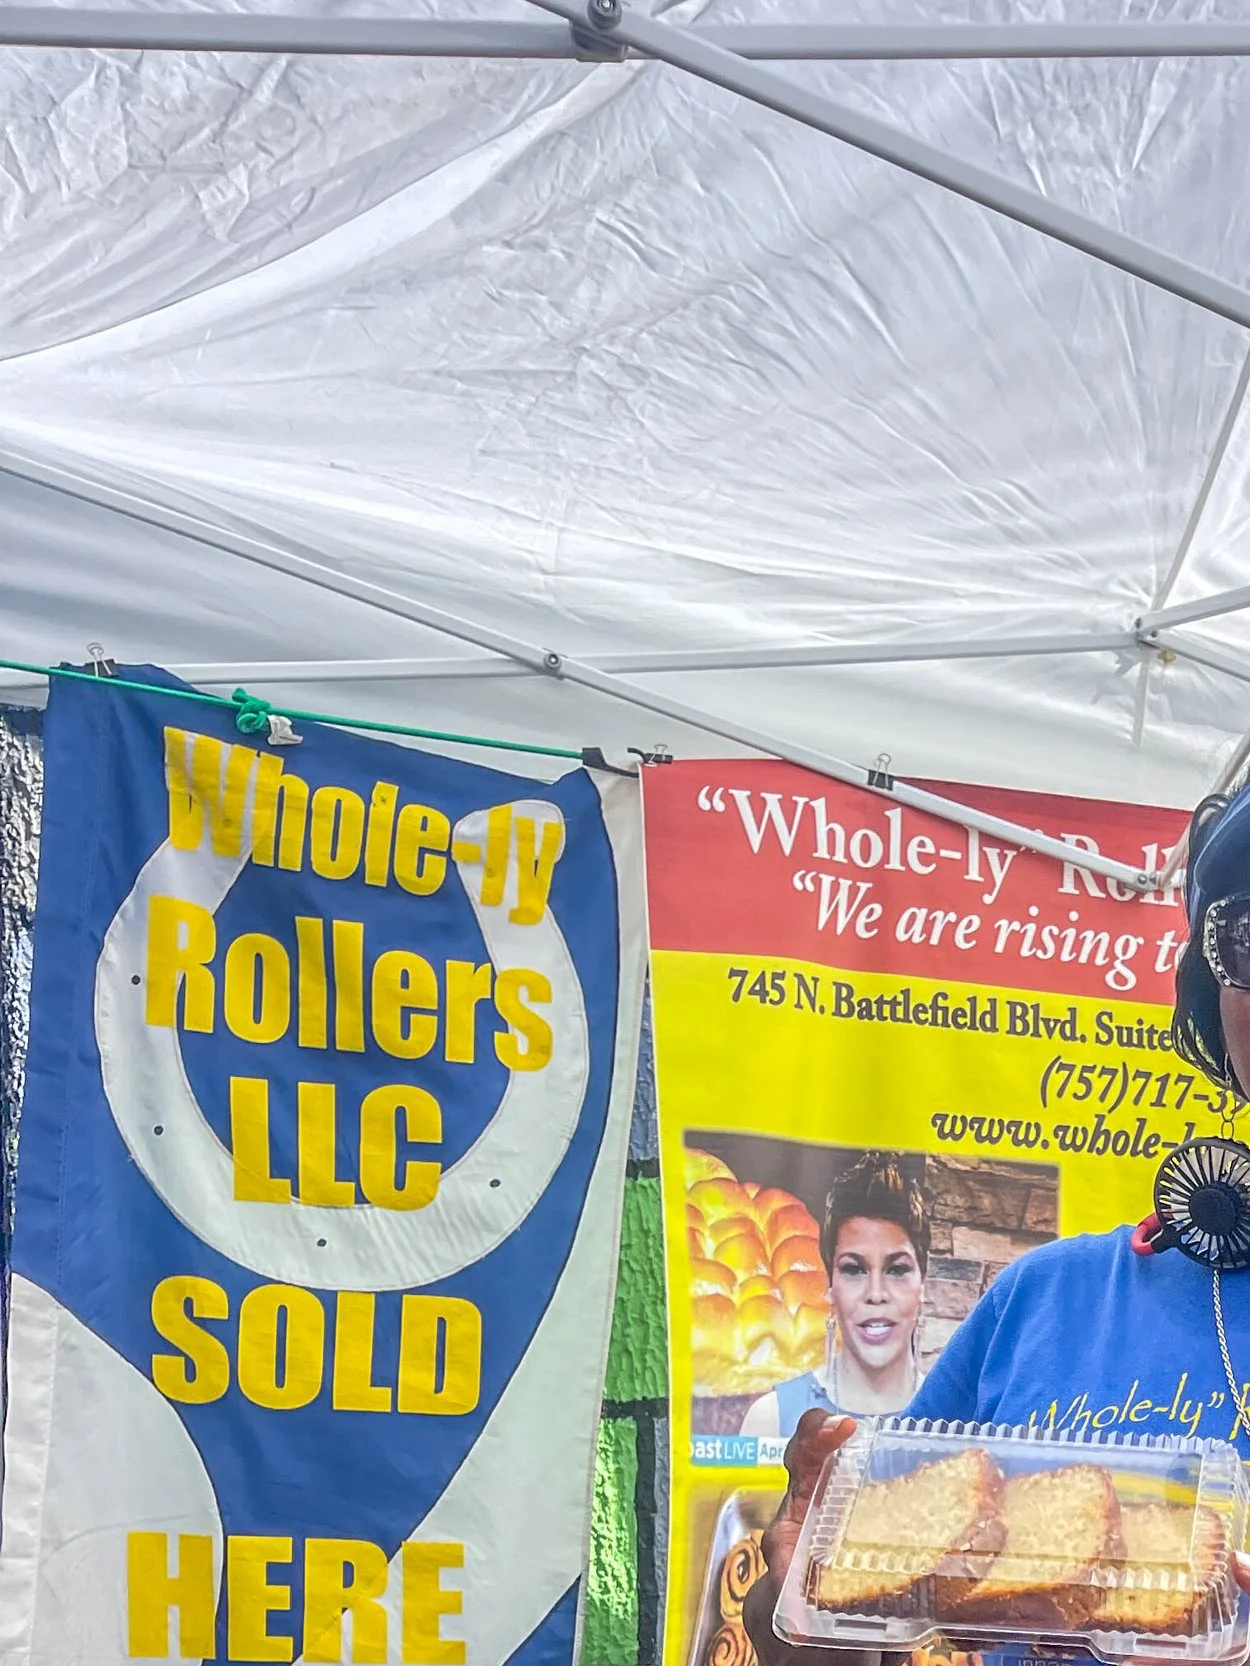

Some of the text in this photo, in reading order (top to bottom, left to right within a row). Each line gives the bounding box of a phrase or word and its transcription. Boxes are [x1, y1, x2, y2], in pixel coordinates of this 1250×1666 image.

[164, 726, 562, 925] Whole-ly
[697, 785, 1042, 904] “Whole-ly
[146, 895, 553, 1072] Rollers
[728, 967, 786, 1006] 745
[795, 974, 825, 1015] N.
[833, 981, 999, 1033] Battlefield
[1007, 1002, 1087, 1044] Blvd.
[1094, 1010, 1173, 1052] Suite
[895, 907, 978, 950] are
[995, 906, 1144, 991] rising
[229, 1076, 443, 1212] LLC
[151, 1275, 482, 1415] SOLD
[127, 1531, 466, 1665] HERE
